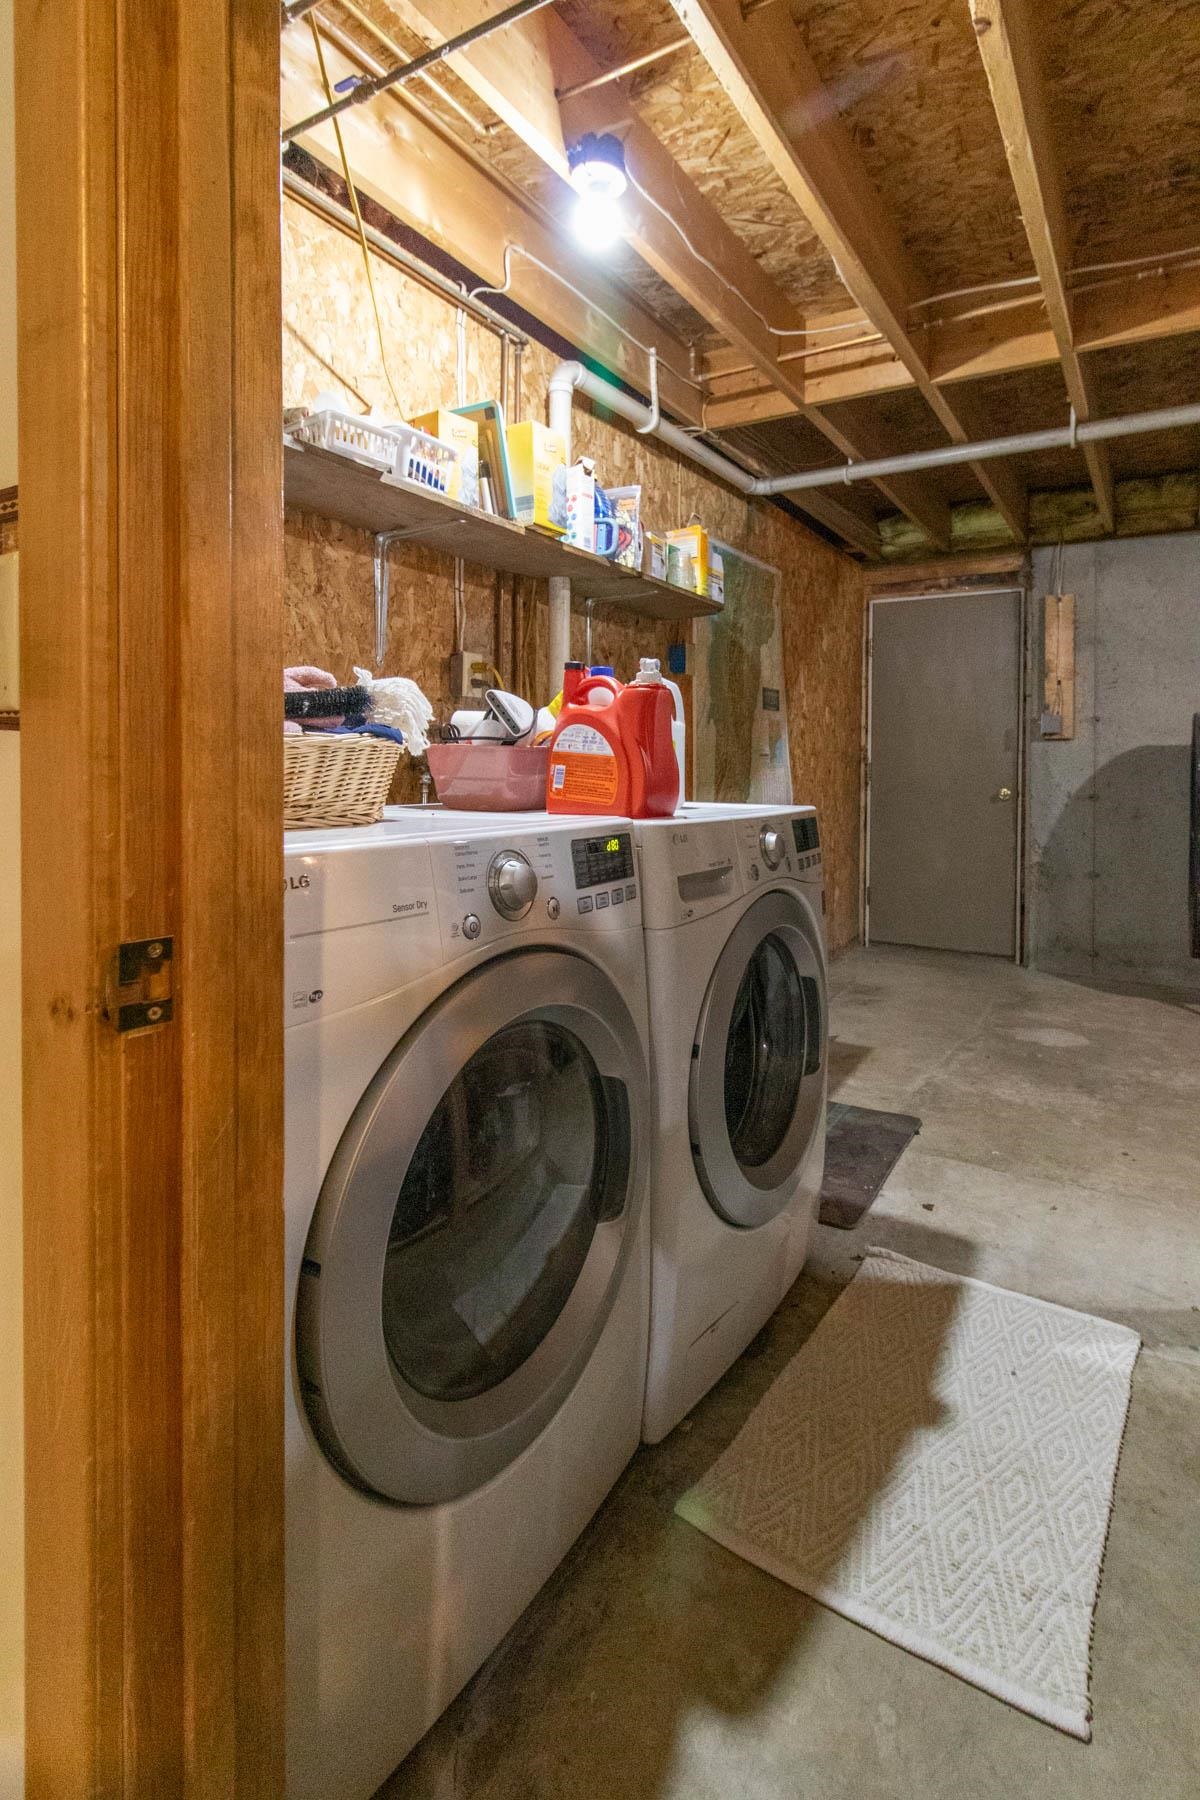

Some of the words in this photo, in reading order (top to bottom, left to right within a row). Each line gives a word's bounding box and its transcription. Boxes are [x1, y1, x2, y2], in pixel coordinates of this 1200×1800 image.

[289, 874, 310, 890] LG
[392, 902, 415, 913] Sensor
[416, 899, 428, 910] Dry
